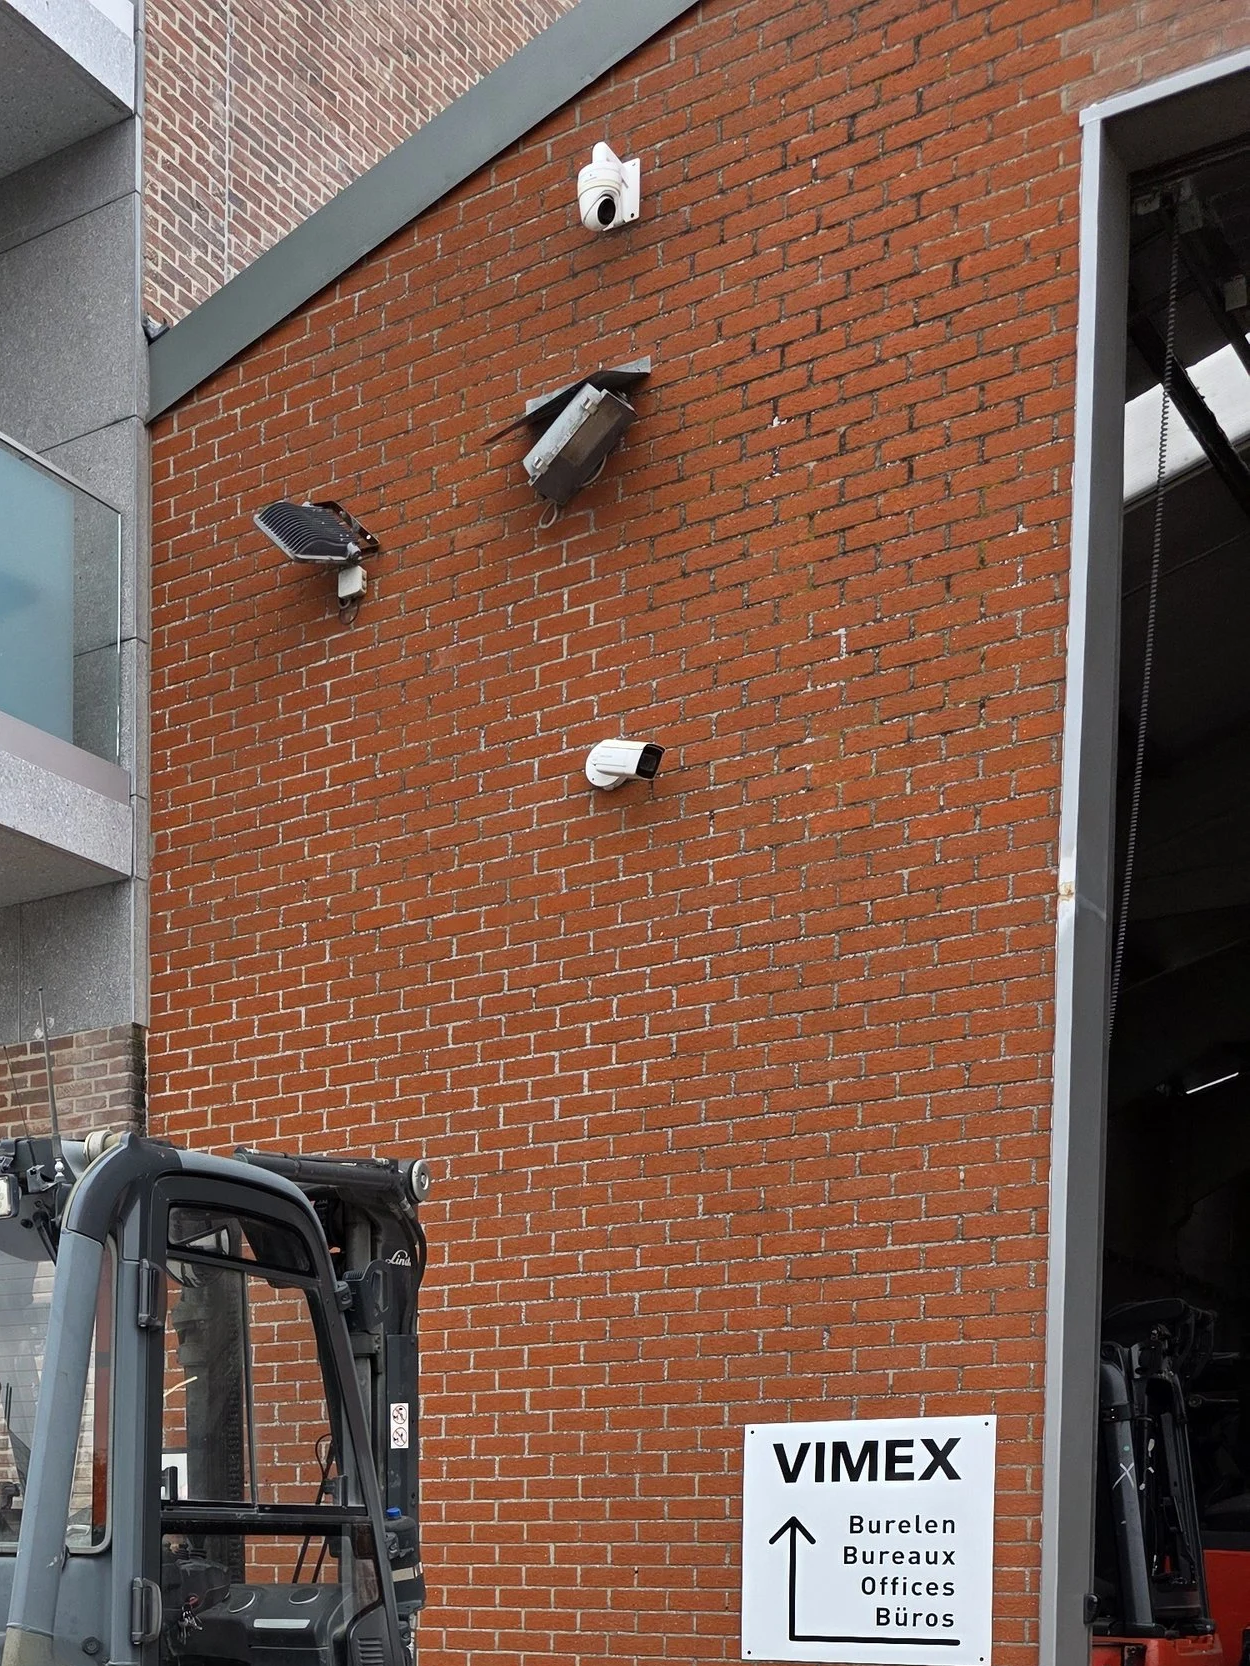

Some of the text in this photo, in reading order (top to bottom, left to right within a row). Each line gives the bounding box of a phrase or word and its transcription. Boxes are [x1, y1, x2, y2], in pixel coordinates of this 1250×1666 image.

[385, 1249, 412, 1267] Lind
[773, 1437, 962, 1484] VIMEX
[849, 1515, 956, 1534] Burelen
[843, 1546, 956, 1565] Bureaux
[861, 1576, 955, 1596] Offices
[876, 1607, 955, 1628] Büros
